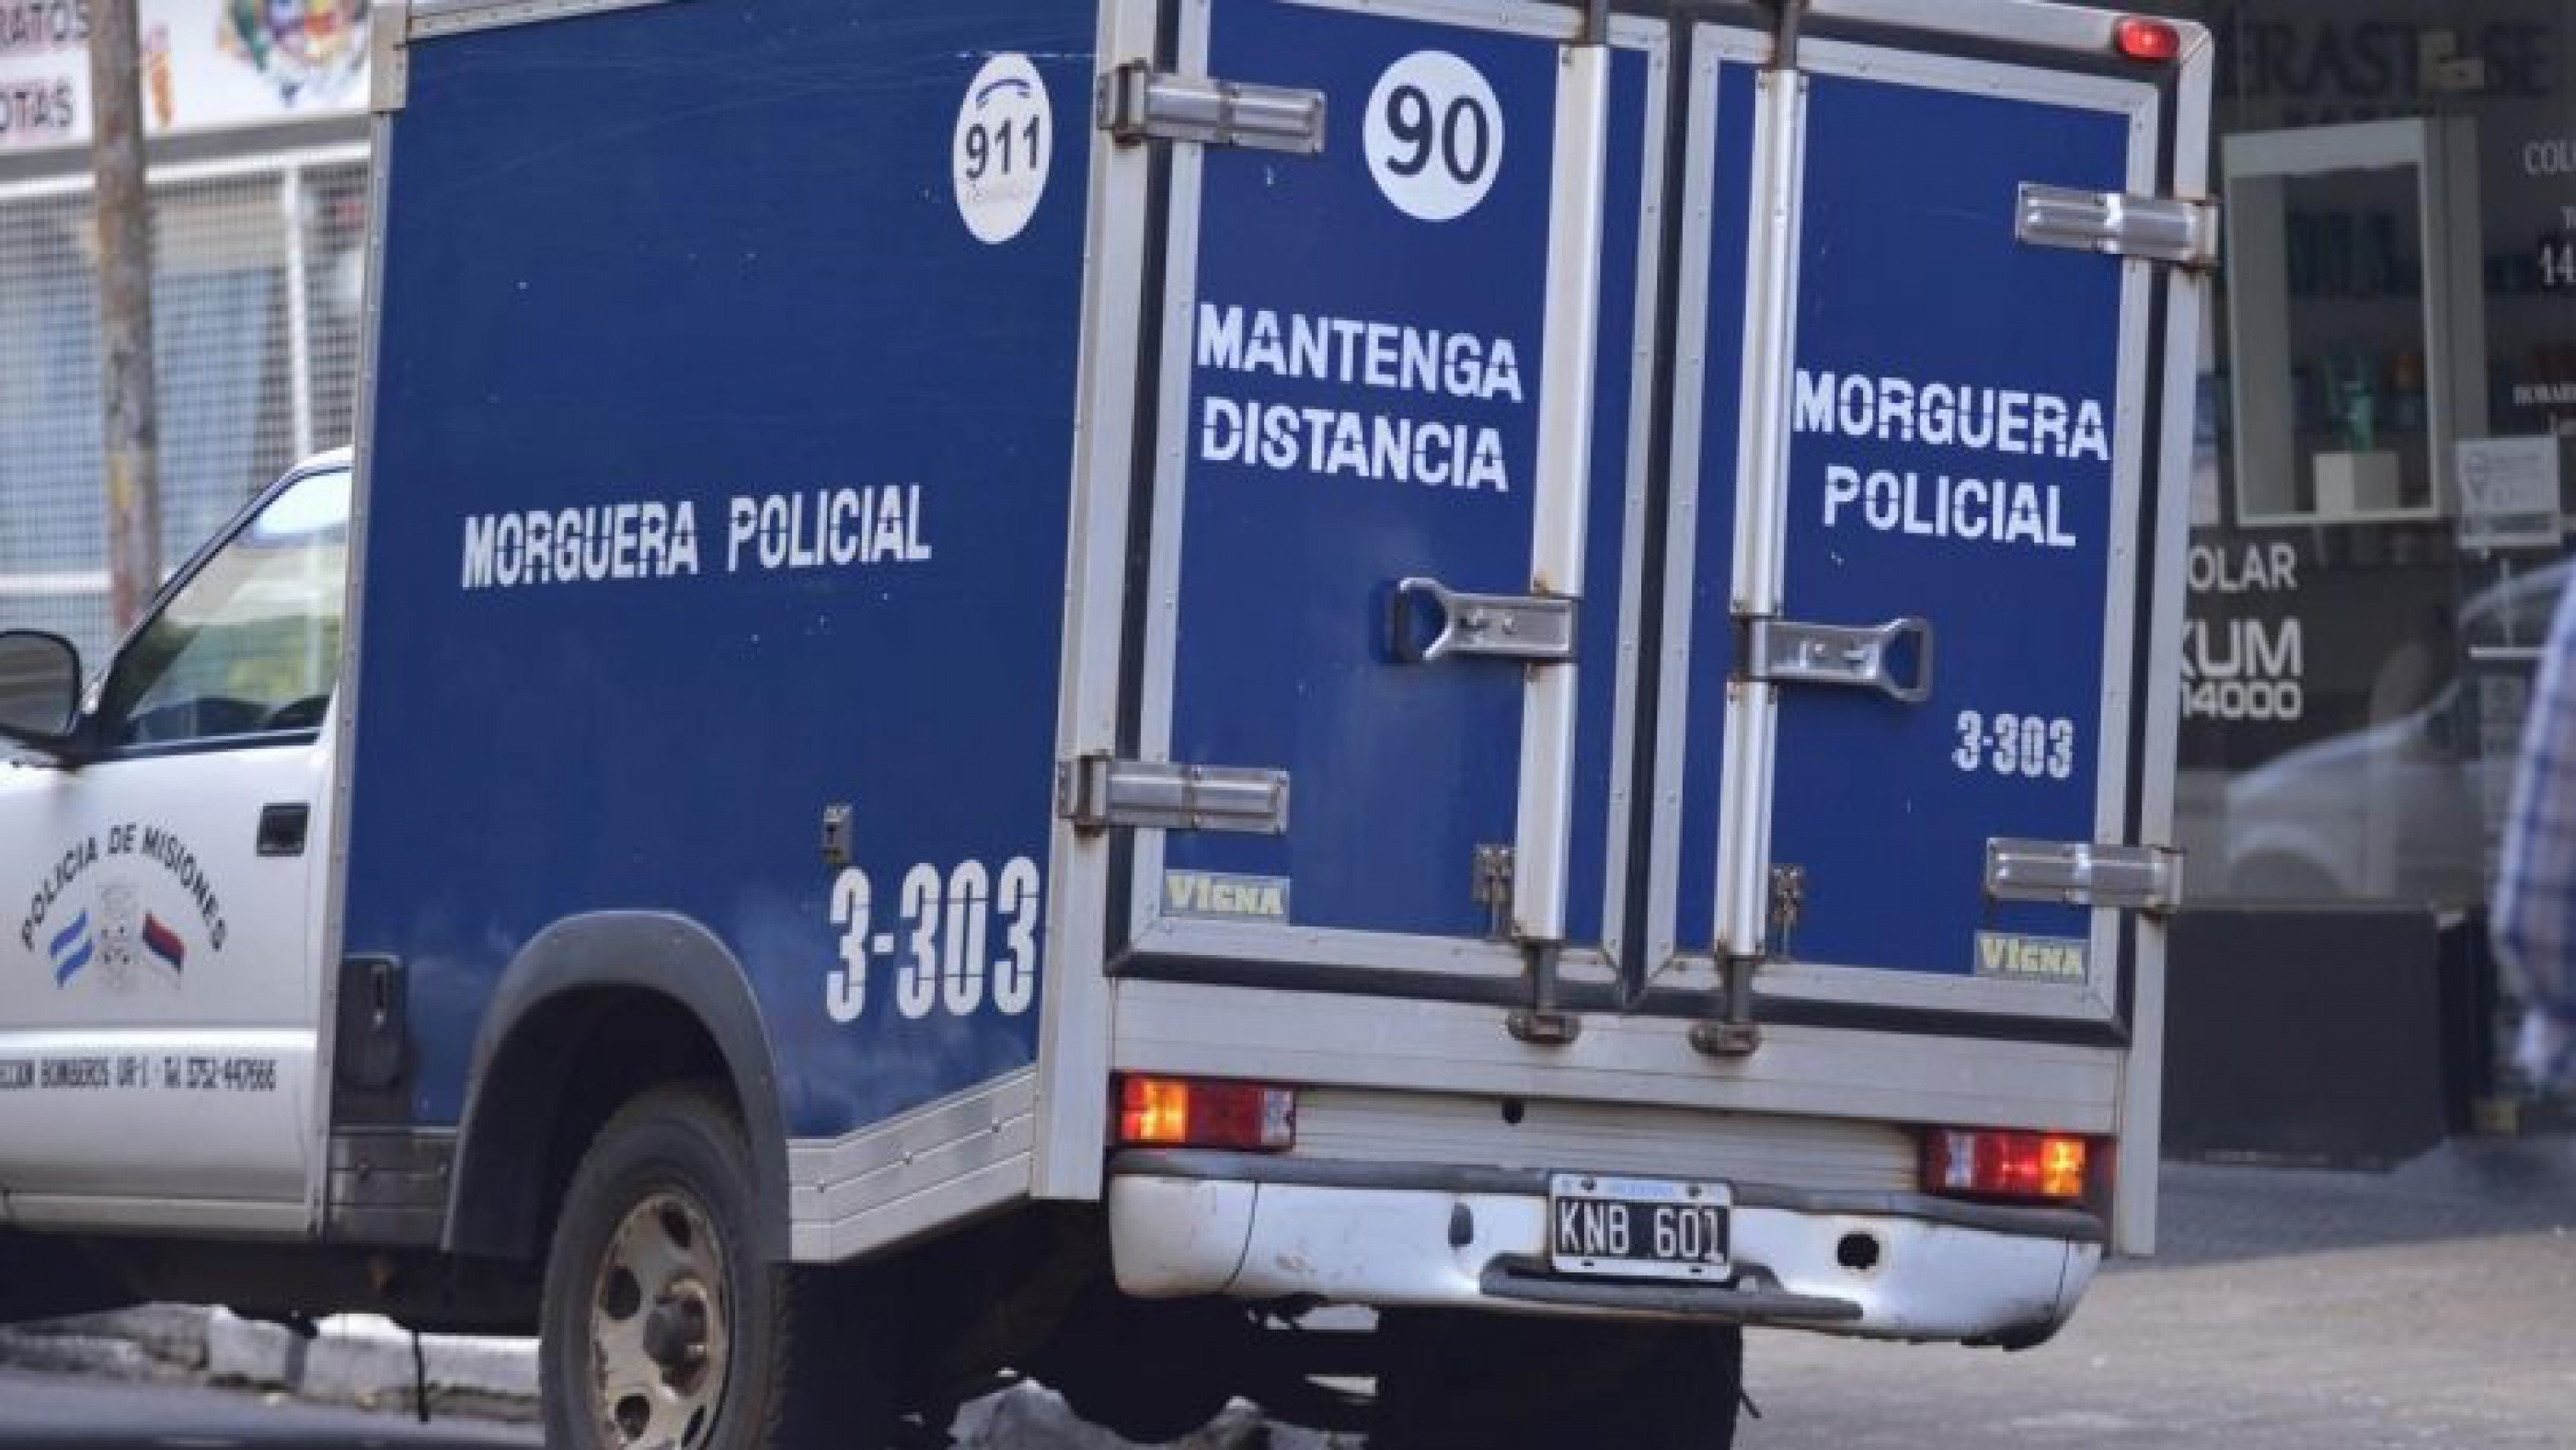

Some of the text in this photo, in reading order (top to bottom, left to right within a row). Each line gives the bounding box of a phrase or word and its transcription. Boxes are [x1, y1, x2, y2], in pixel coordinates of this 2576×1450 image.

[965, 114, 1041, 180] 911
[1385, 85, 1489, 184] 90
[1197, 302, 1523, 402] MANTENGA
[1200, 396, 1509, 493] DISTANCIA
[1794, 367, 2109, 461] MORGUERA
[462, 485, 933, 591] MORGUERA POLICIAL
[1823, 463, 2076, 547] POLICIAL
[1951, 710, 2075, 779] 3-303
[22, 823, 227, 951] POLICIA DE MISIONES
[1167, 874, 1284, 916] VIGNA
[827, 856, 1041, 1022] 3-303
[1979, 937, 2084, 975] VIGNA
[1561, 1202, 1725, 1263] KNB 601
